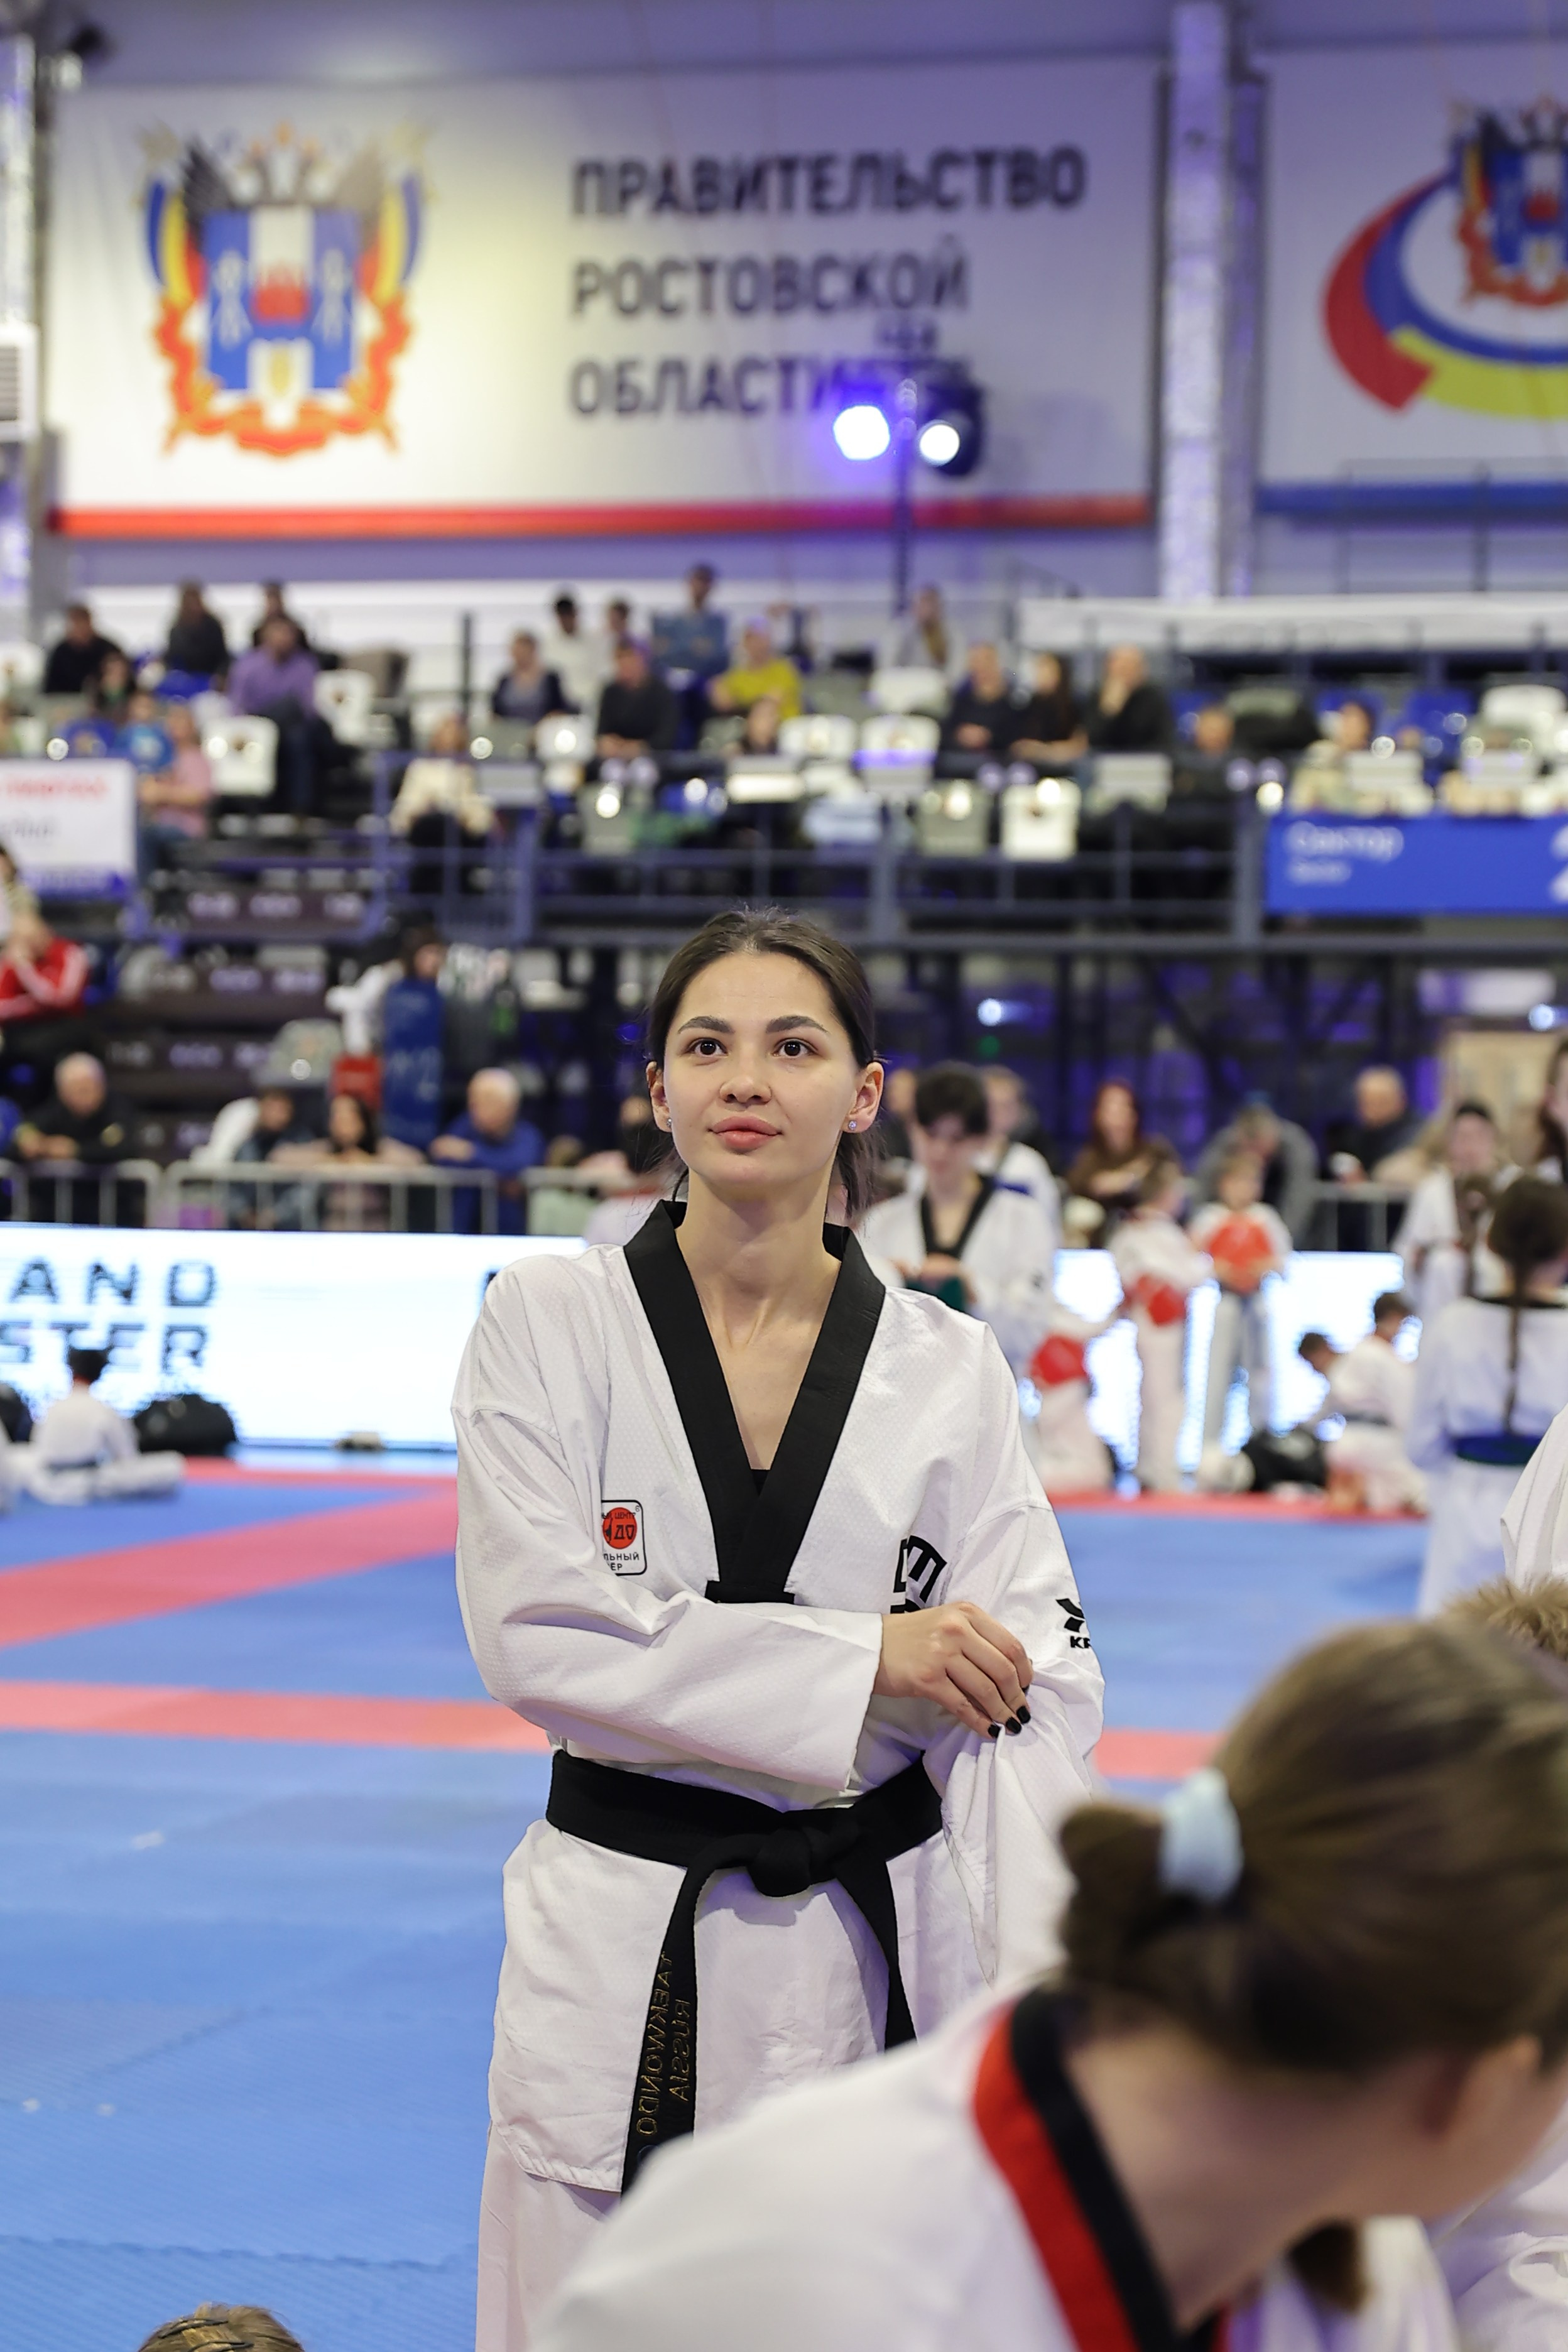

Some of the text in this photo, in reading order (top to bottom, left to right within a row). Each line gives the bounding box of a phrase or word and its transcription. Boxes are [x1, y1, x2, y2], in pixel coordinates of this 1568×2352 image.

[571, 144, 1088, 216] ПРАВИТЕЛЬСТВО
[572, 234, 971, 317] РОСТОВСКОЙ
[9, 1259, 217, 1307] AND
